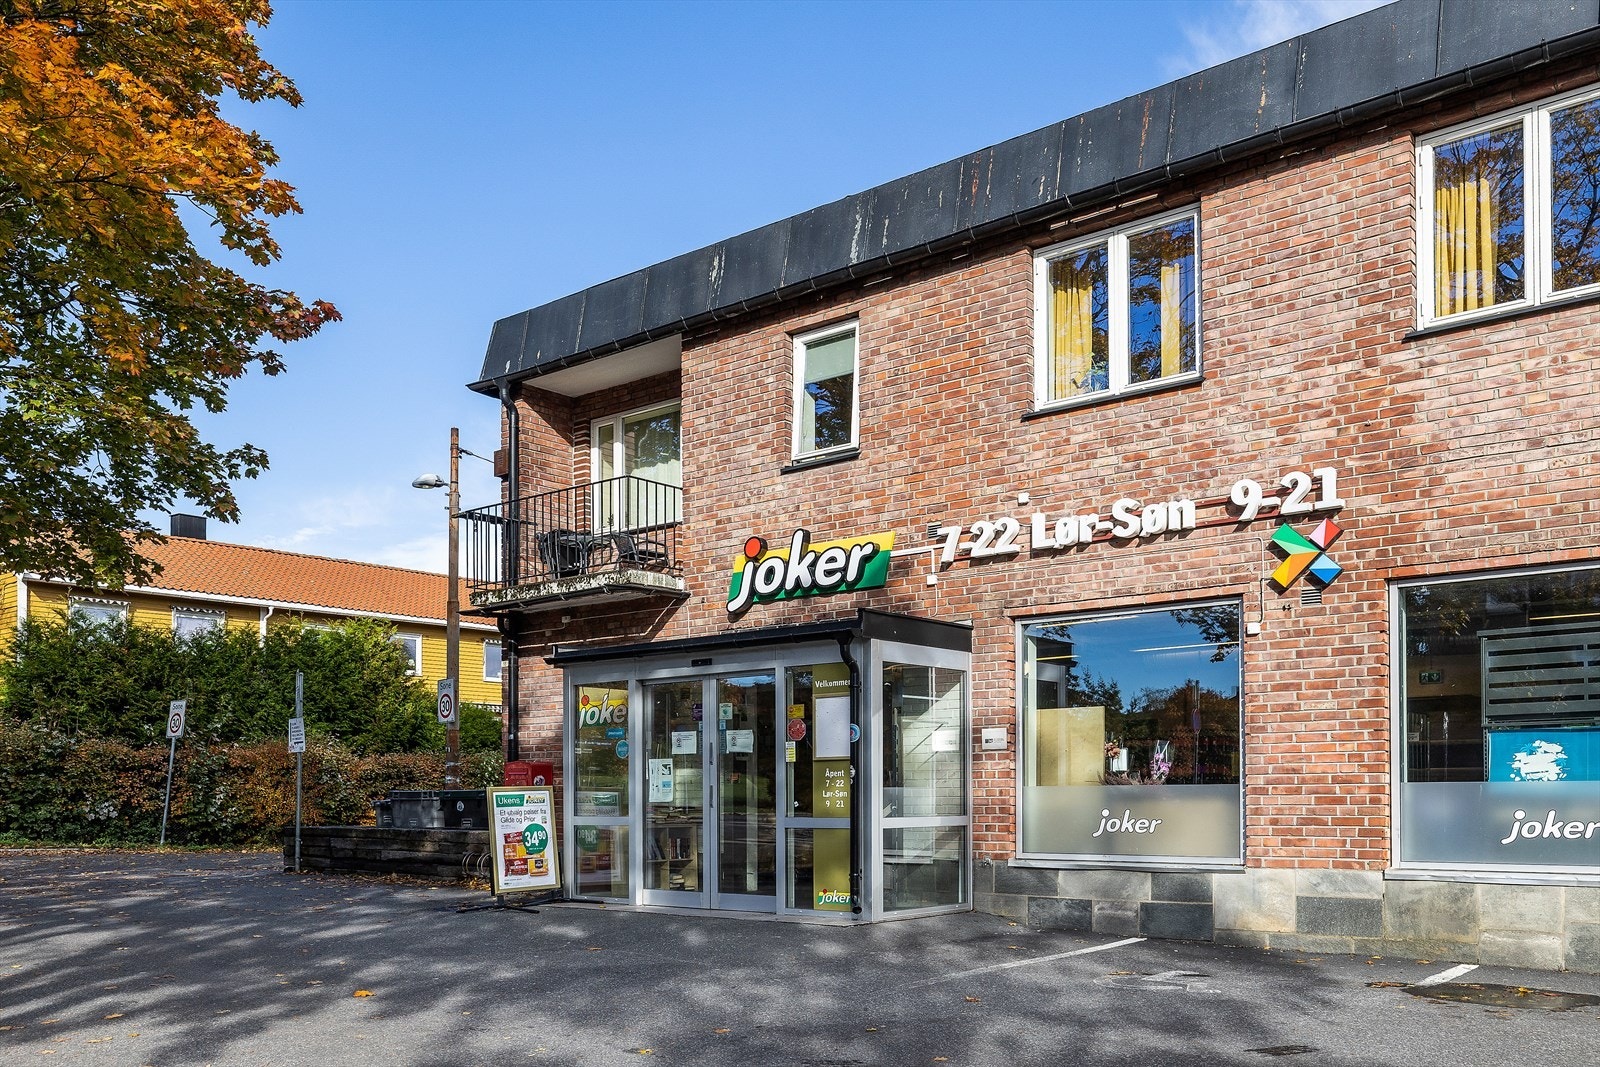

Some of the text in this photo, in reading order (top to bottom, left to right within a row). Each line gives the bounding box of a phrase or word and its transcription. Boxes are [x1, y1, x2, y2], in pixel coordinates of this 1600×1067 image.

[937, 466, 1346, 563] 7-22 Lør-Søn 9-21
[726, 529, 881, 614] joker
[440, 682, 452, 690] Sone
[441, 700, 450, 713] 30
[578, 693, 628, 730] joke
[171, 718, 180, 729] 30
[825, 768, 845, 778] Åpent
[825, 780, 830, 788] 7
[822, 790, 848, 798] Lør-Søn
[497, 797, 521, 805] Ukens
[825, 800, 845, 808] 9 21
[1092, 808, 1163, 838] joker
[1500, 809, 1600, 845] joker
[818, 889, 851, 905] joker
